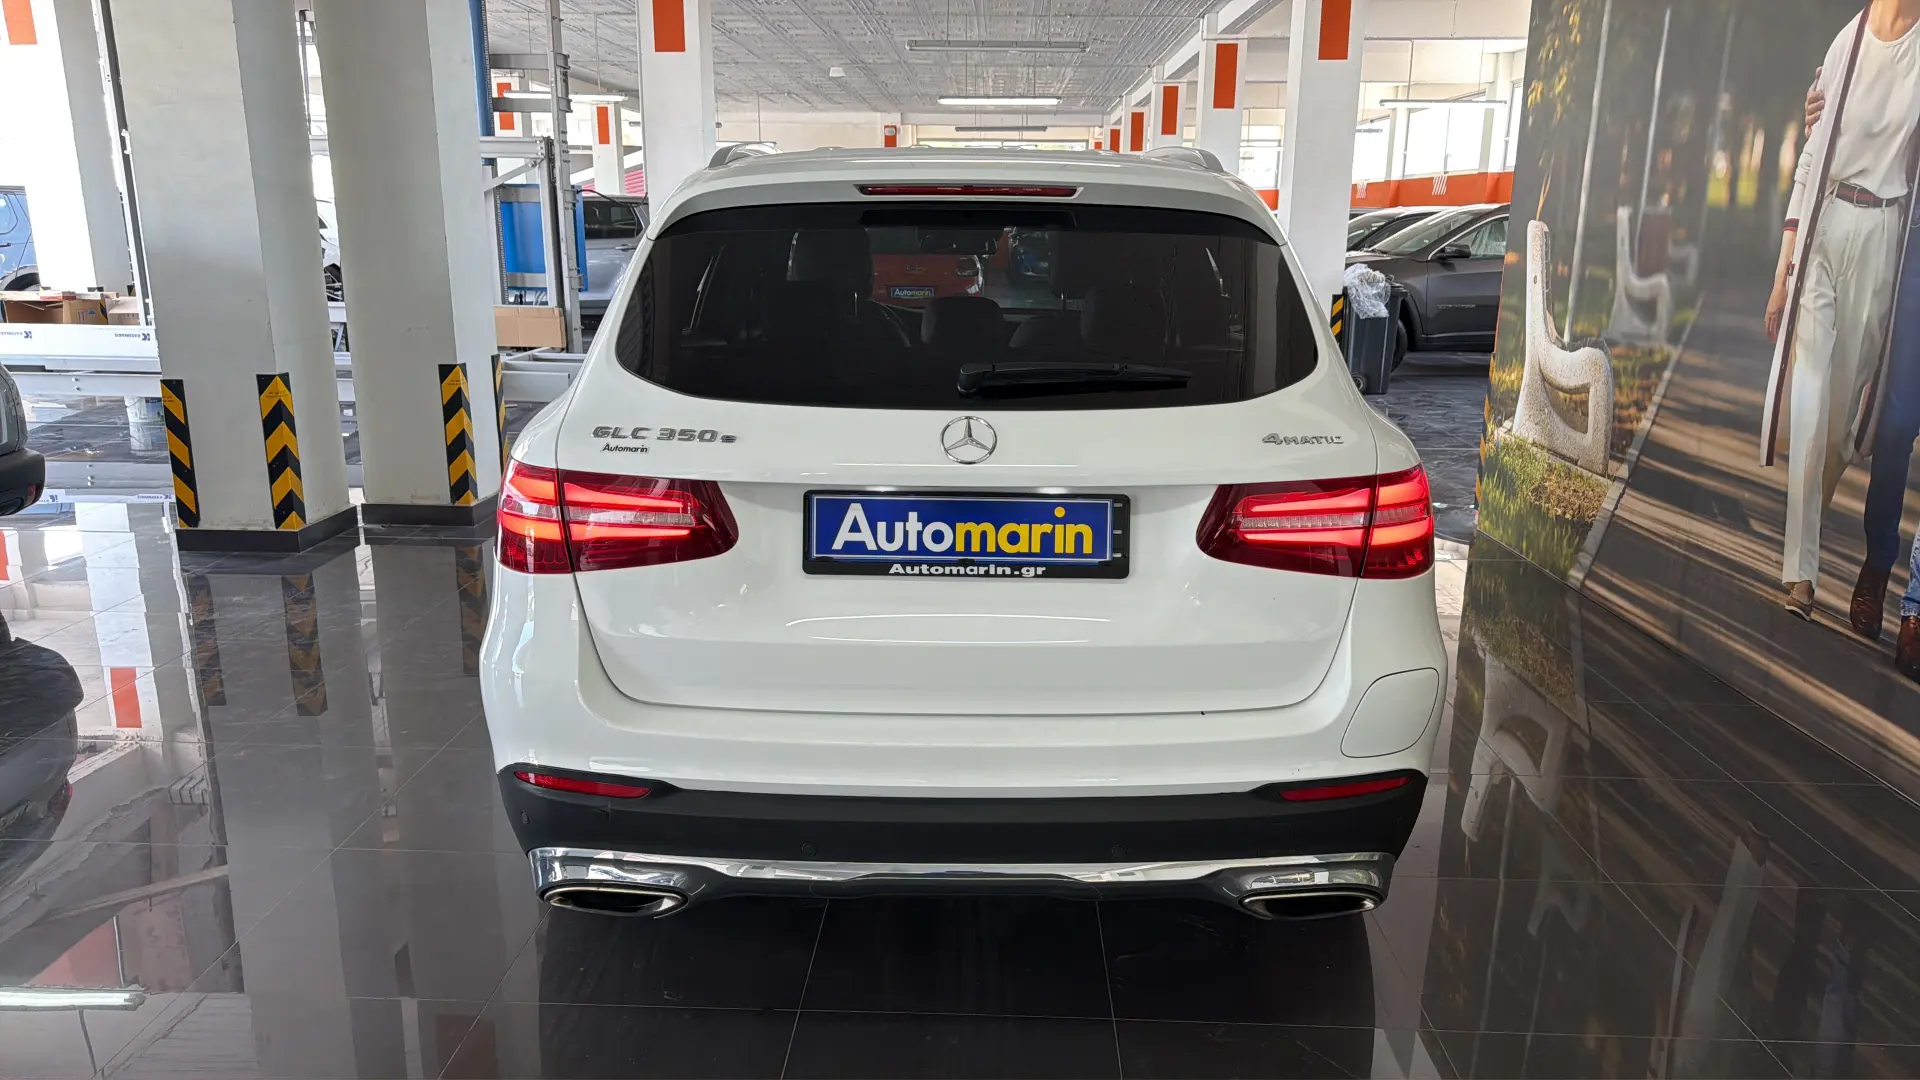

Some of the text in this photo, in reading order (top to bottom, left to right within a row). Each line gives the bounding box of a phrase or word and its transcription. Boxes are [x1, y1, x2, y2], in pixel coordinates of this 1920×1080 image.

[591, 426, 651, 439] GLC
[1262, 432, 1344, 445] 4MATIC
[602, 443, 649, 453] Automarin
[831, 502, 1093, 554] Automarin
[889, 563, 1046, 577] Automarin.gr
